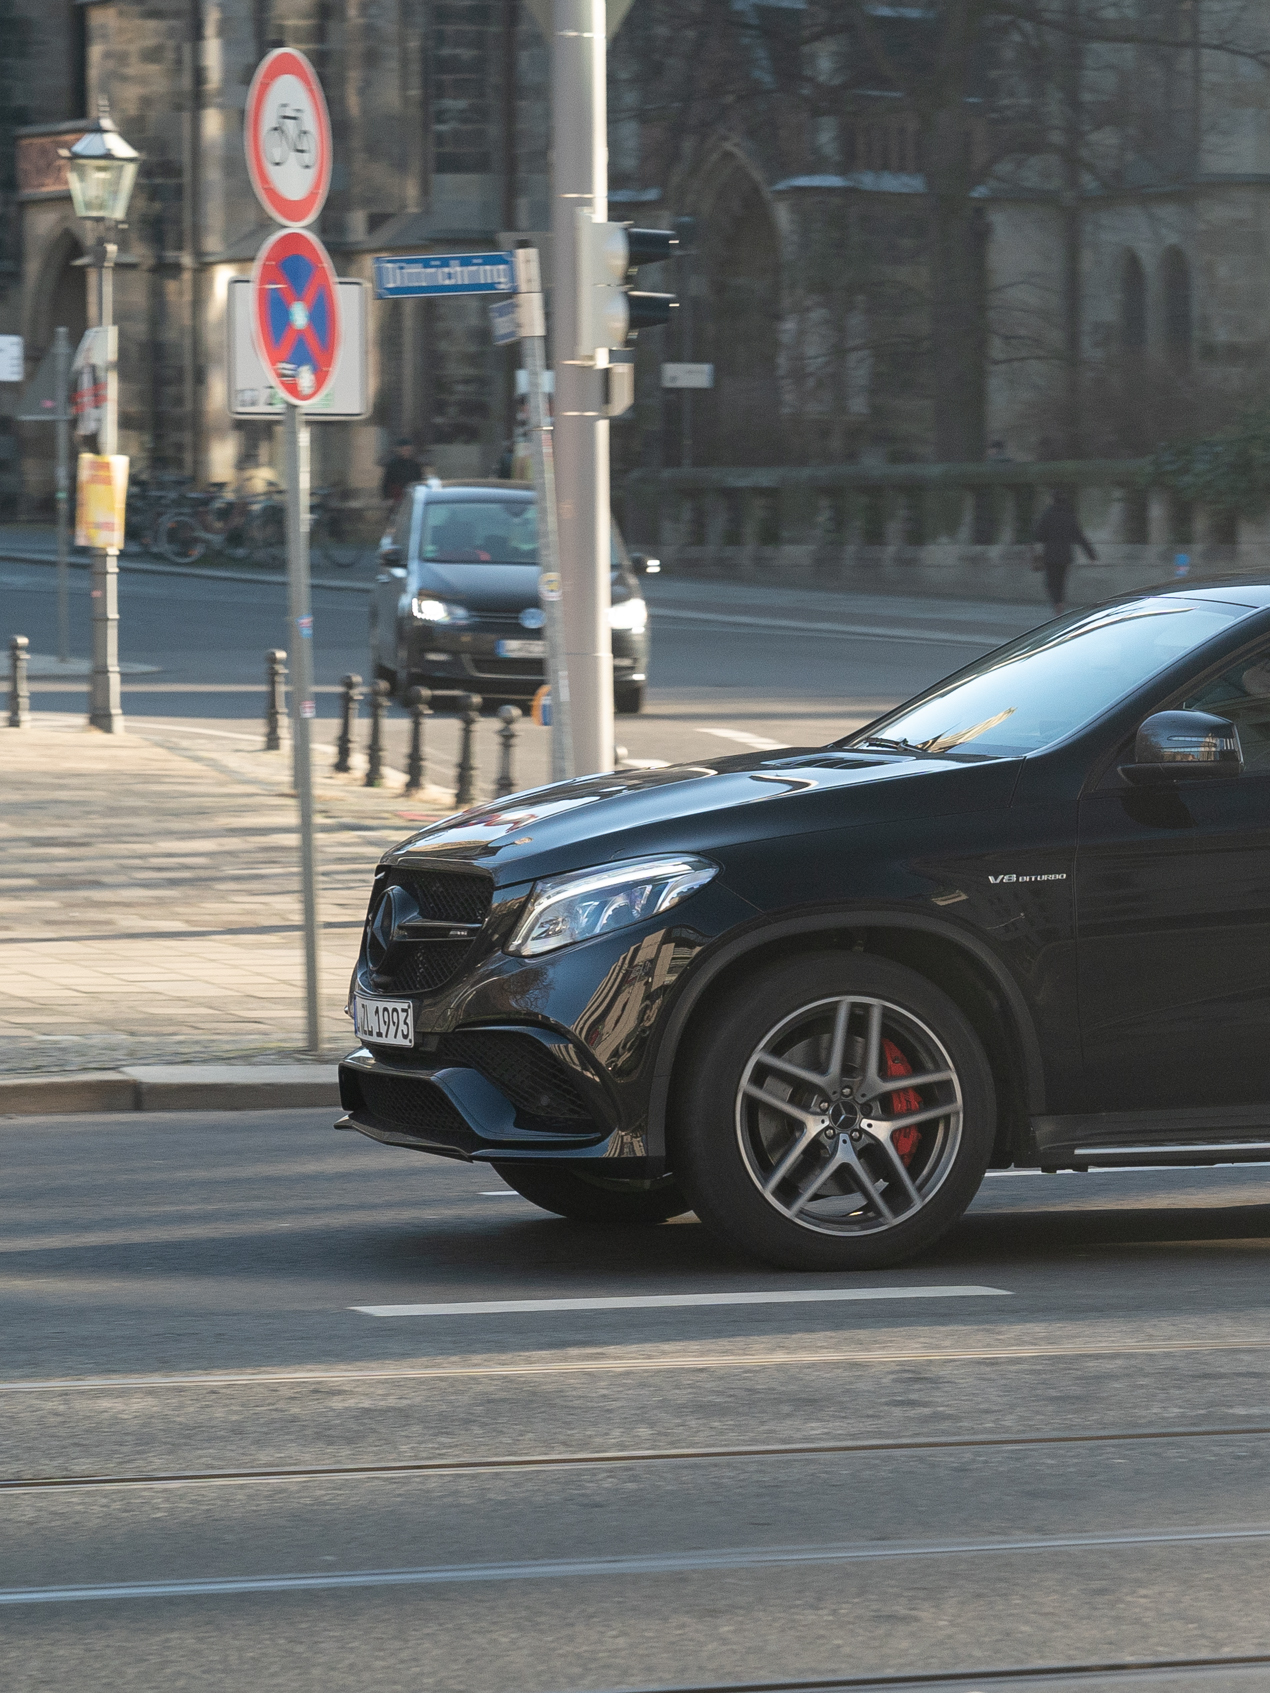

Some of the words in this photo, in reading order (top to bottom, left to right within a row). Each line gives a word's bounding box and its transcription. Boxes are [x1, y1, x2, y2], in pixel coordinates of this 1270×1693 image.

[988, 874, 1017, 884] V8
[1018, 873, 1067, 882] BITURBO
[375, 1006, 410, 1040] 1993
